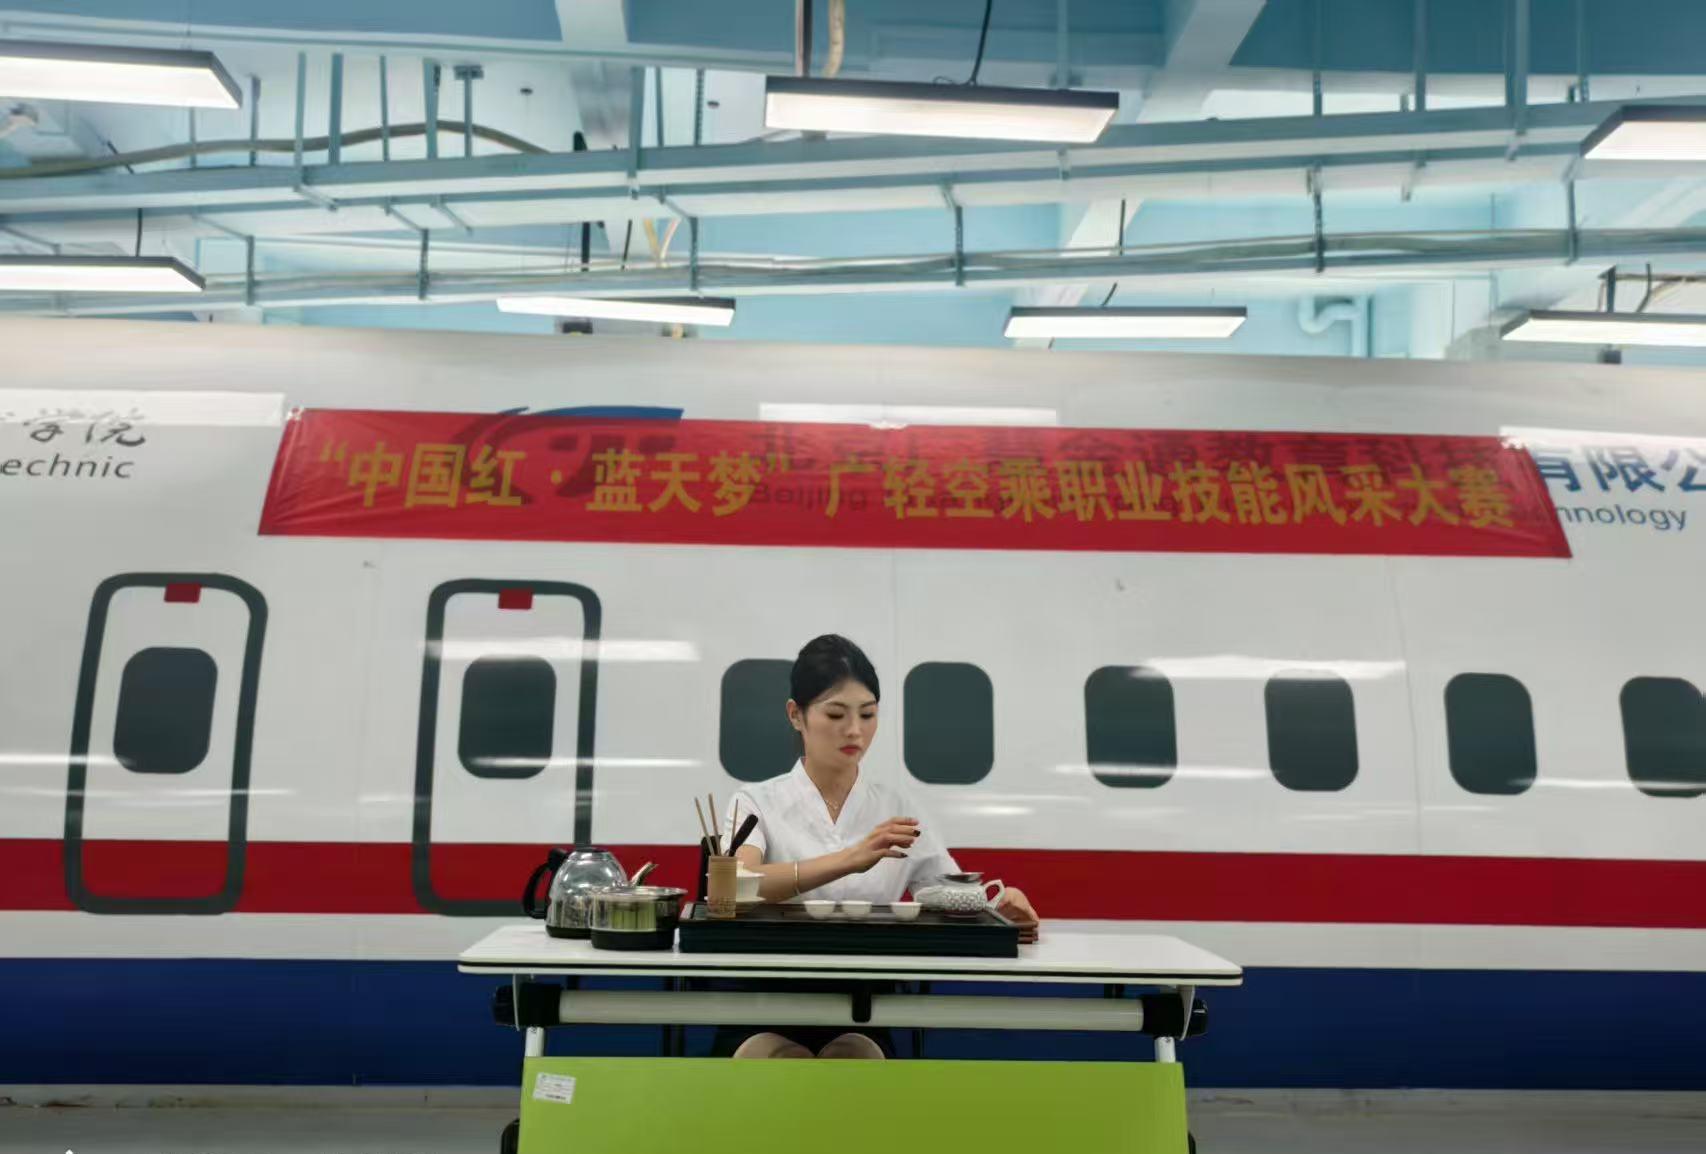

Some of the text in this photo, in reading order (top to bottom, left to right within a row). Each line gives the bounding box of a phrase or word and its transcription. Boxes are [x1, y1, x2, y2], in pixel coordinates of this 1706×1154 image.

[0, 406, 147, 447] 学院
[0, 453, 135, 479] echnic
[825, 450, 1515, 530] 广轻空乘职业技能风采大赛
